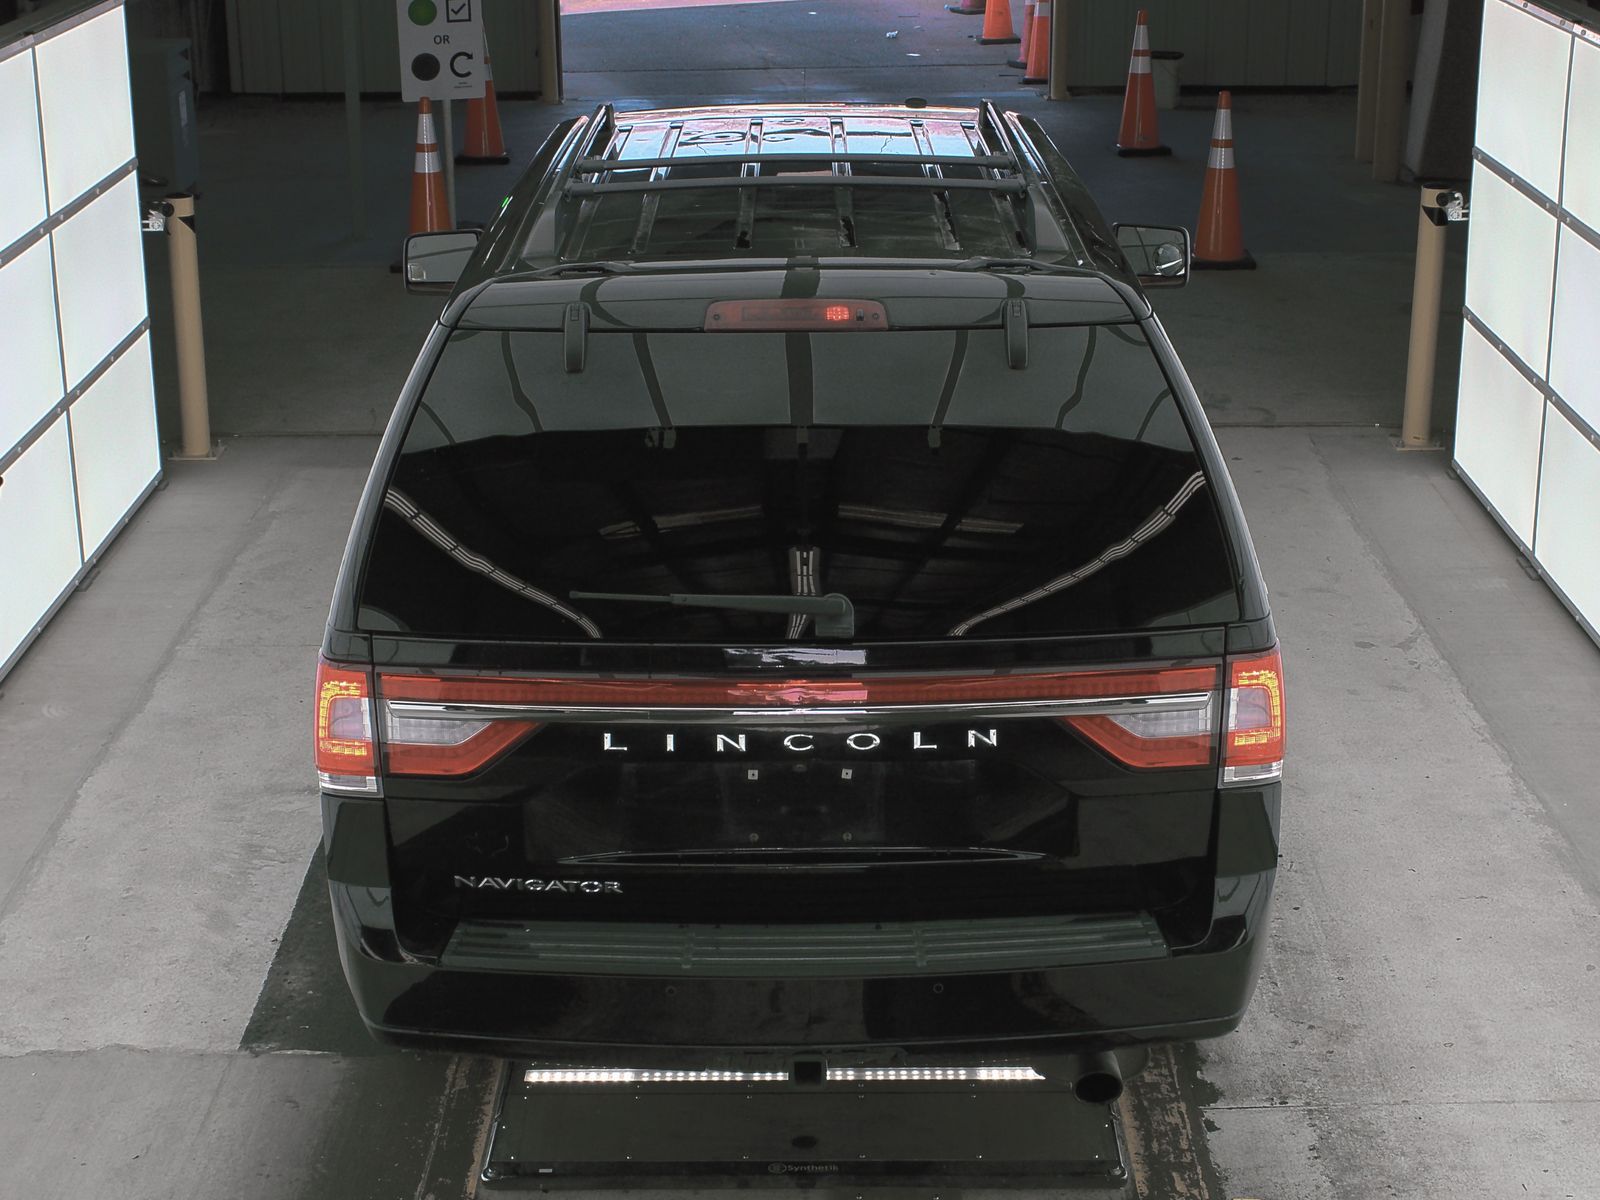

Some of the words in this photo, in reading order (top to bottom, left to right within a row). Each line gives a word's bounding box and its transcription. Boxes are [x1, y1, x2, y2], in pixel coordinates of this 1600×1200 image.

[433, 34, 450, 45] OR
[603, 729, 998, 752] LINCOLN
[454, 875, 624, 894] NAVIGATOR
